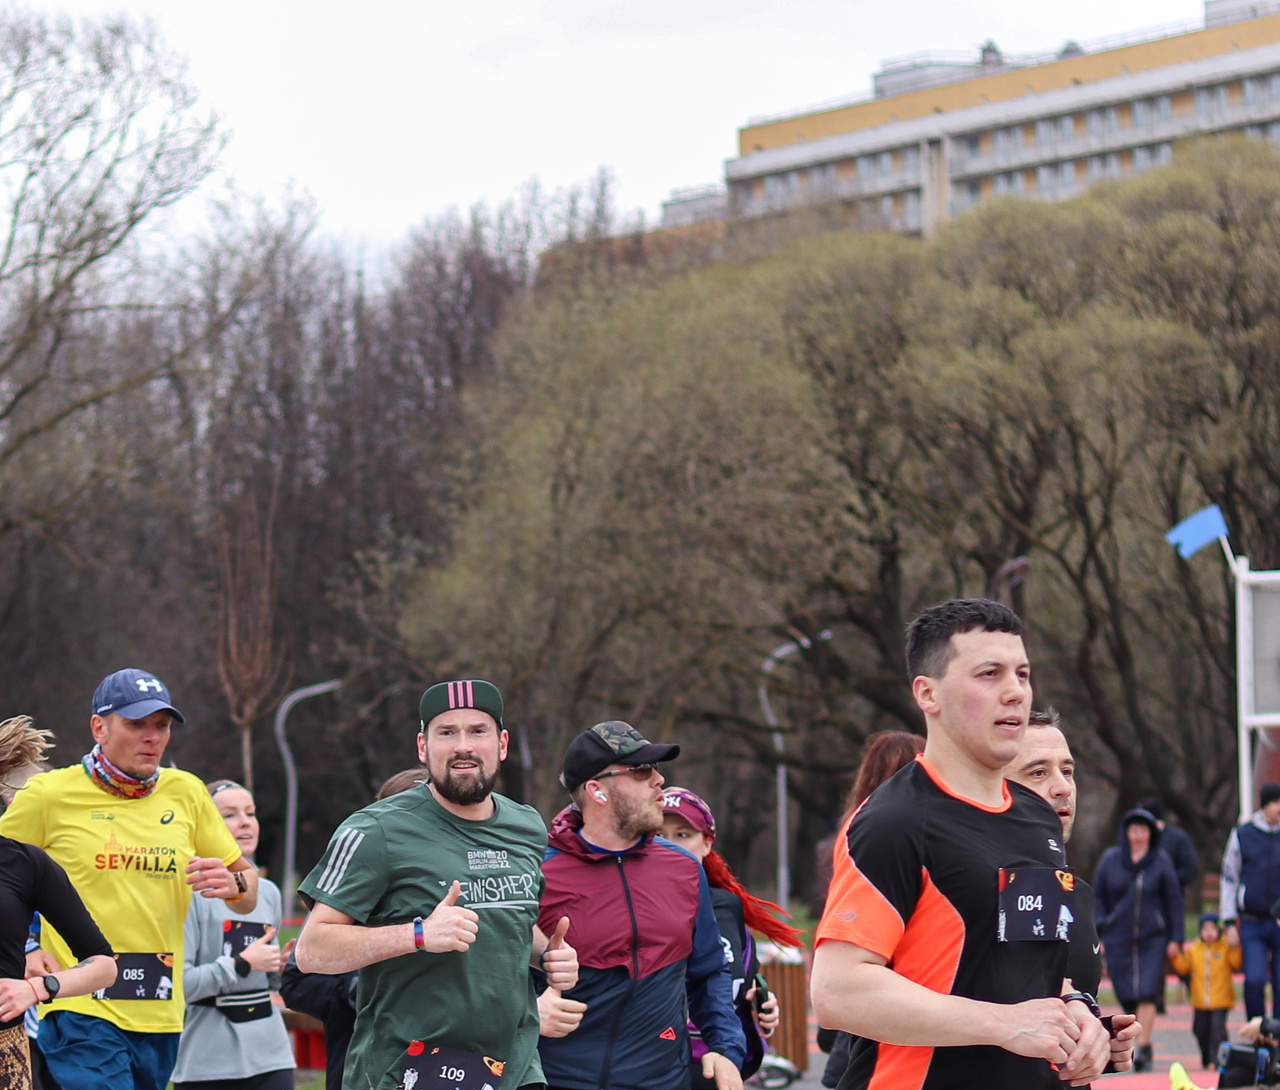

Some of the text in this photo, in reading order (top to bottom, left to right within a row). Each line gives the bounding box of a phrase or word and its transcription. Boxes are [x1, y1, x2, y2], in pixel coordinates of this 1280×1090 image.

[467, 850, 508, 860] BMW 20
[497, 860, 511, 869] 22
[1017, 895, 1044, 912] 084
[122, 968, 145, 981] 085
[439, 1065, 466, 1082] 109
